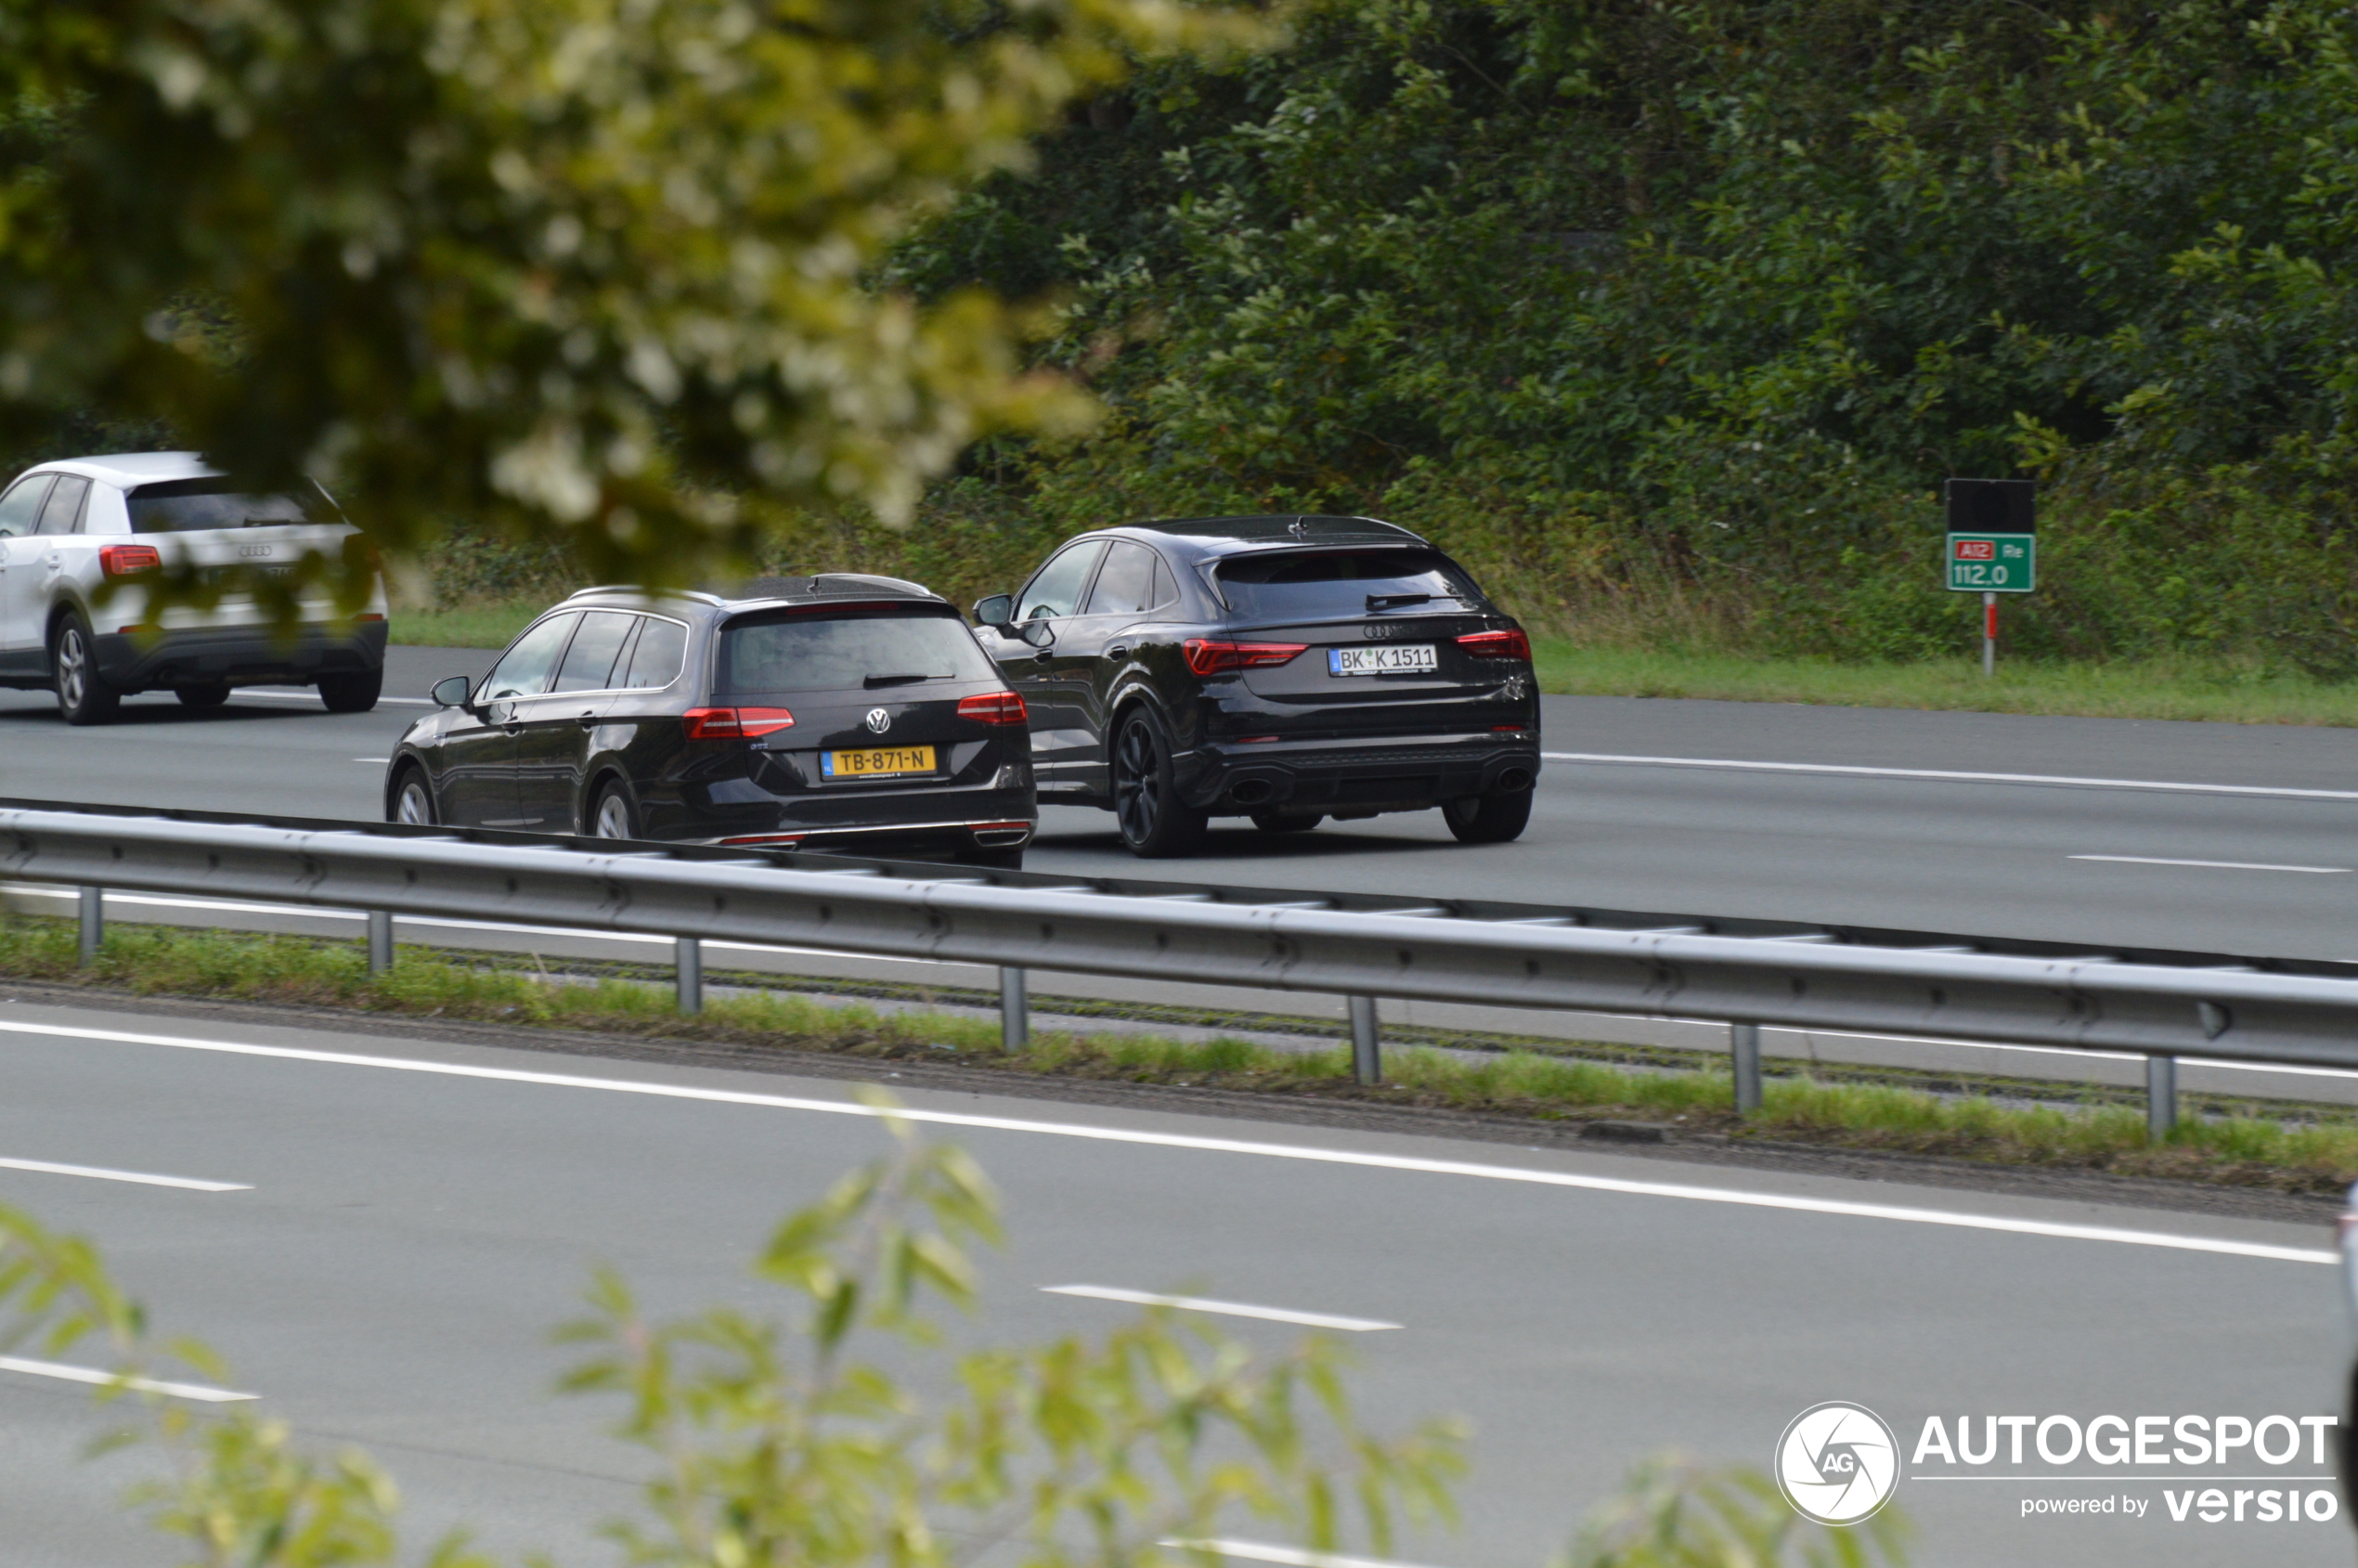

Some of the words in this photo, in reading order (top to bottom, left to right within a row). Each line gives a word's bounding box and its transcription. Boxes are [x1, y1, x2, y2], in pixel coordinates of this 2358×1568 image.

[1960, 544, 1989, 557] A12
[2002, 544, 2024, 558] Re
[1954, 564, 2008, 585] 112.0
[1341, 651, 1364, 668] BK
[1376, 650, 1387, 667] K
[1392, 649, 1434, 667] 1511
[840, 750, 925, 771] TB-871-N
